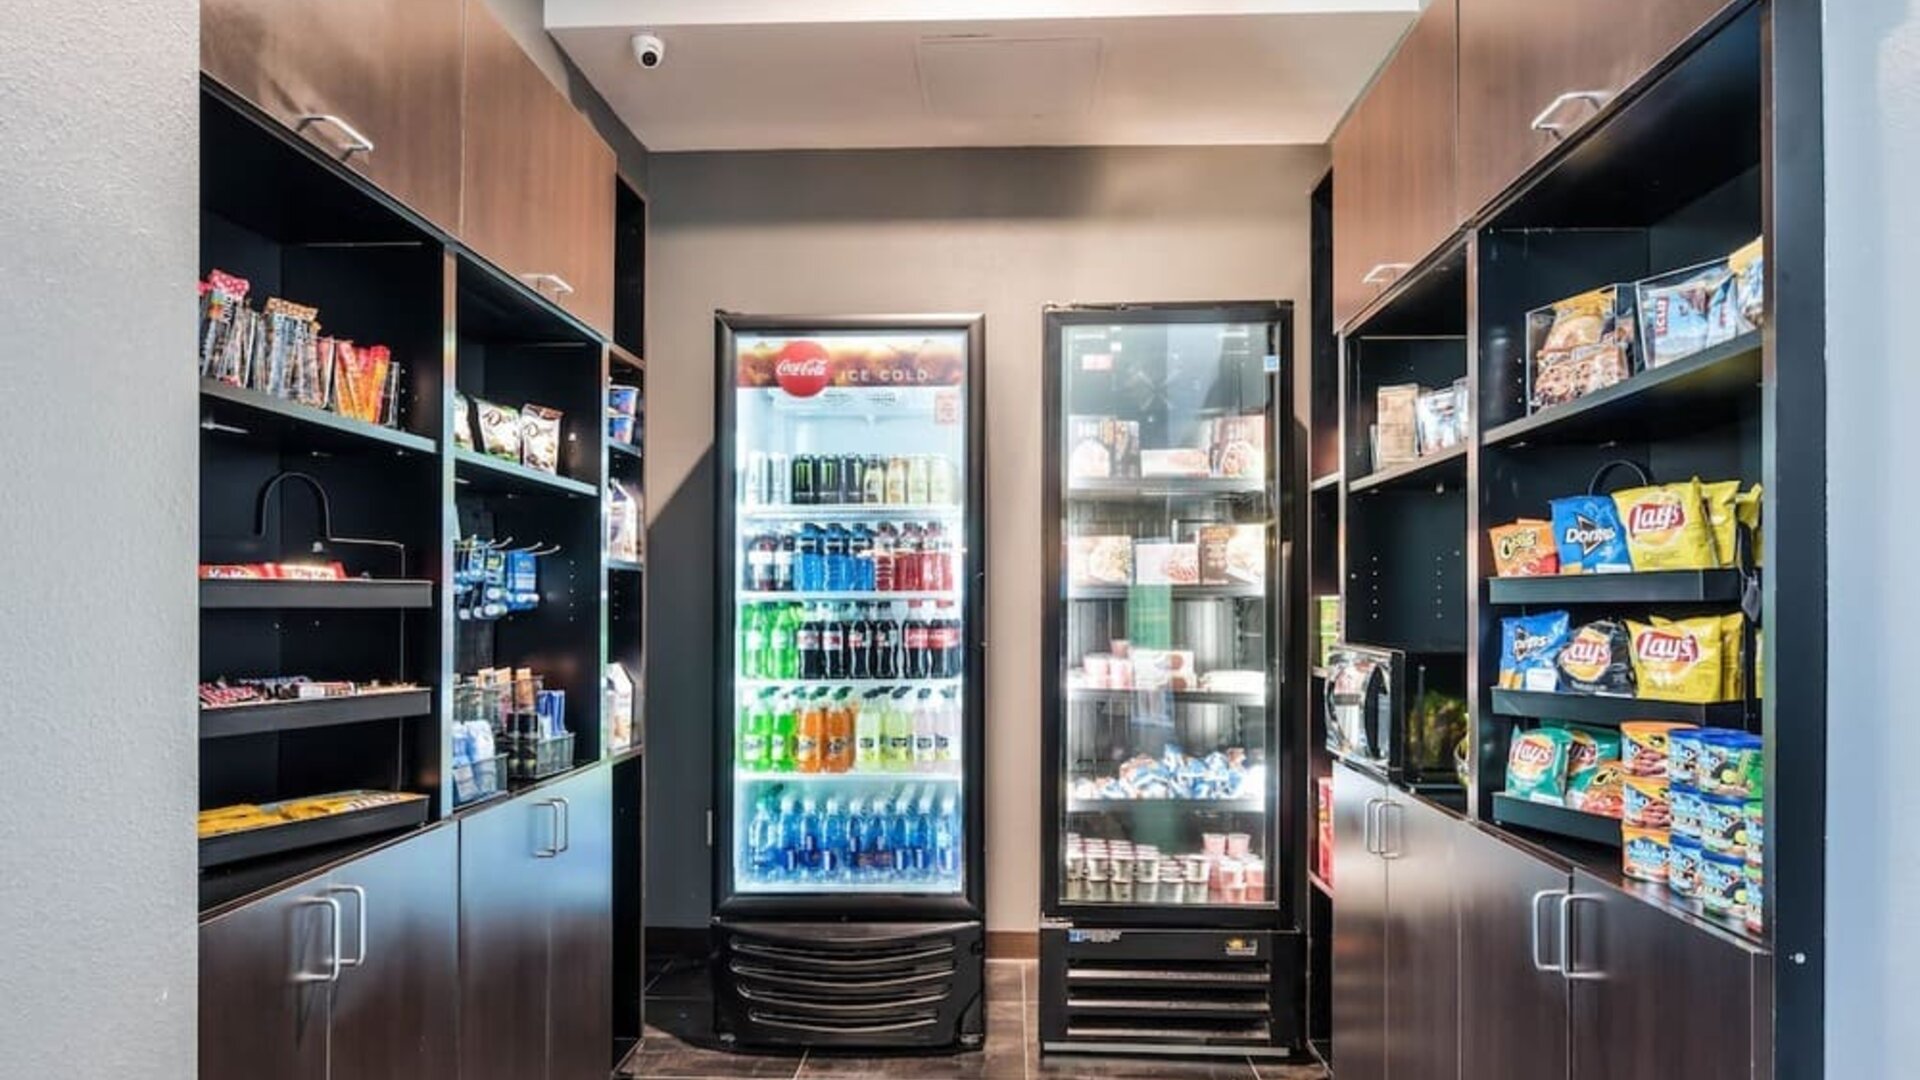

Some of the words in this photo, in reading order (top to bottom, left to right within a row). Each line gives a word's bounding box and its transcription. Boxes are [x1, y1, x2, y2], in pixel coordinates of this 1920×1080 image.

[776, 358, 828, 377] Coca-Cola
[841, 369, 870, 382] ICE
[879, 369, 928, 382] COLD
